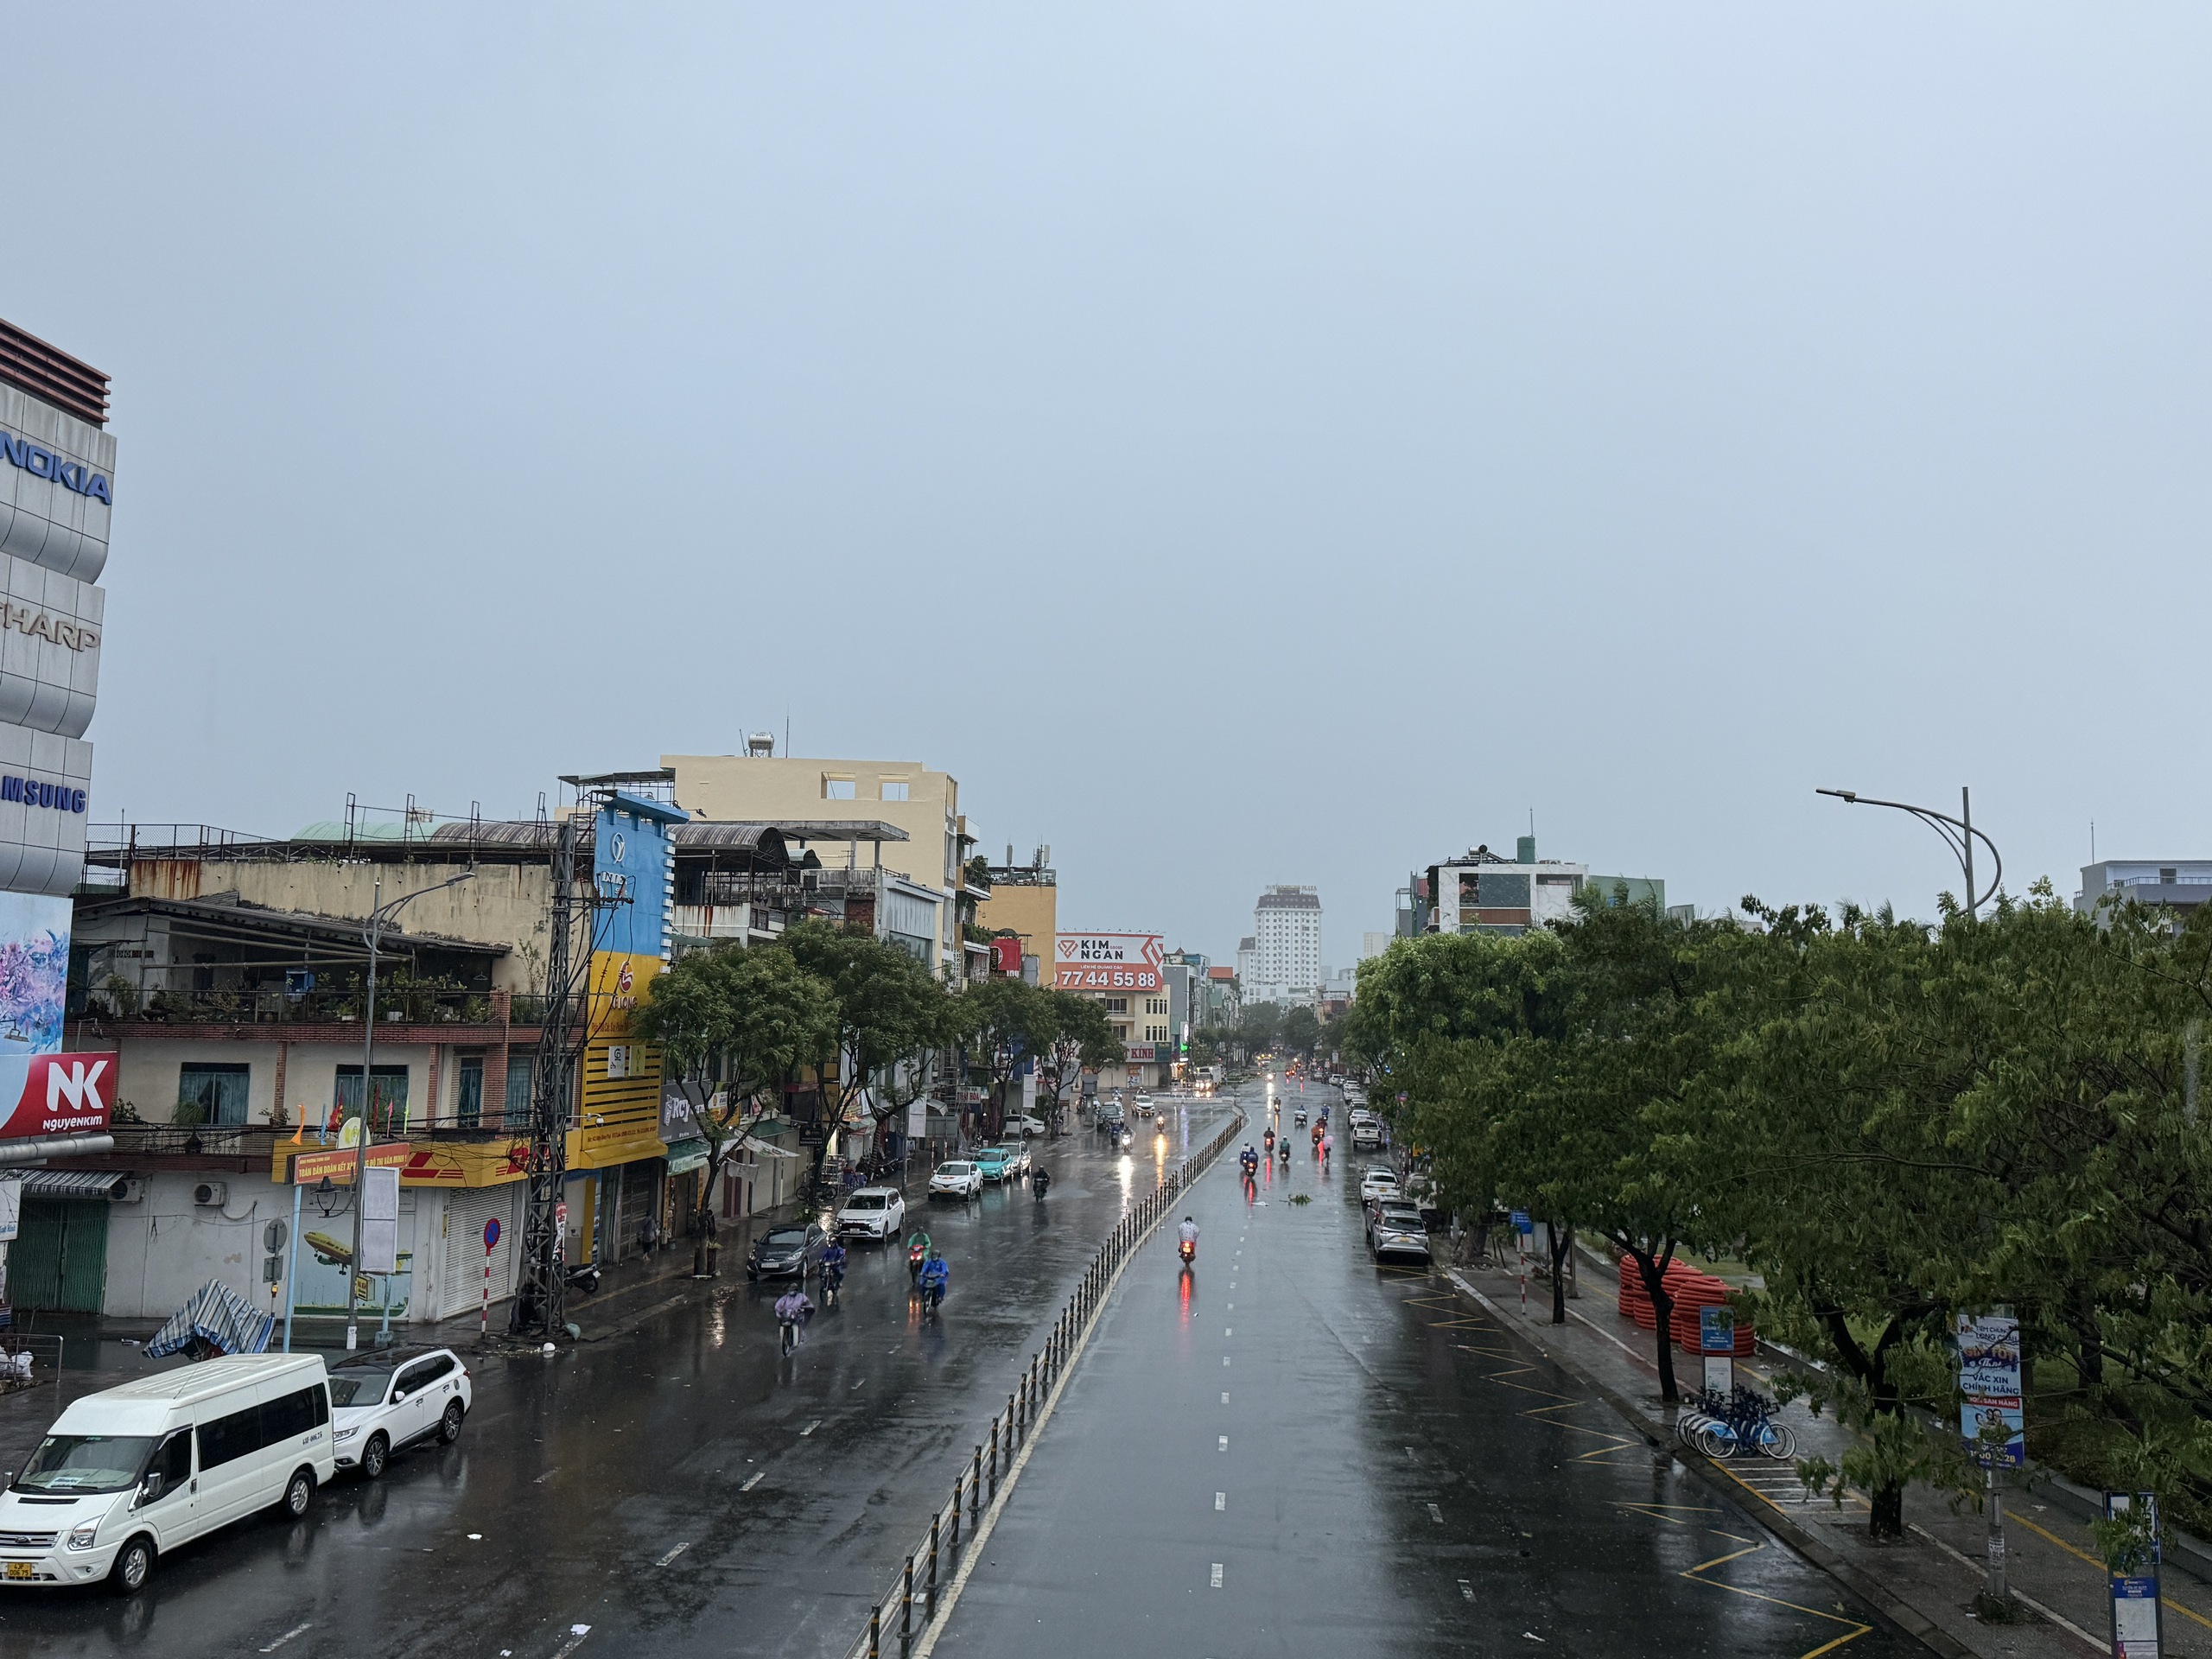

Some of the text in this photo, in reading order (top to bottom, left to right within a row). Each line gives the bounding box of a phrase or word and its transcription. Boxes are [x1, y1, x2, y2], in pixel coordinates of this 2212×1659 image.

[0, 430, 111, 505] NOKIA
[1081, 940, 1109, 950] KIM
[1081, 950, 1123, 960] NGAN
[1130, 1045, 1154, 1058] KÍNH
[47, 1060, 109, 1112] NK
[337, 1160, 346, 1172] KẾT
[1993, 1376, 2009, 1384] XIN
[1962, 1382, 2019, 1395] CHÍNH HÃNG
